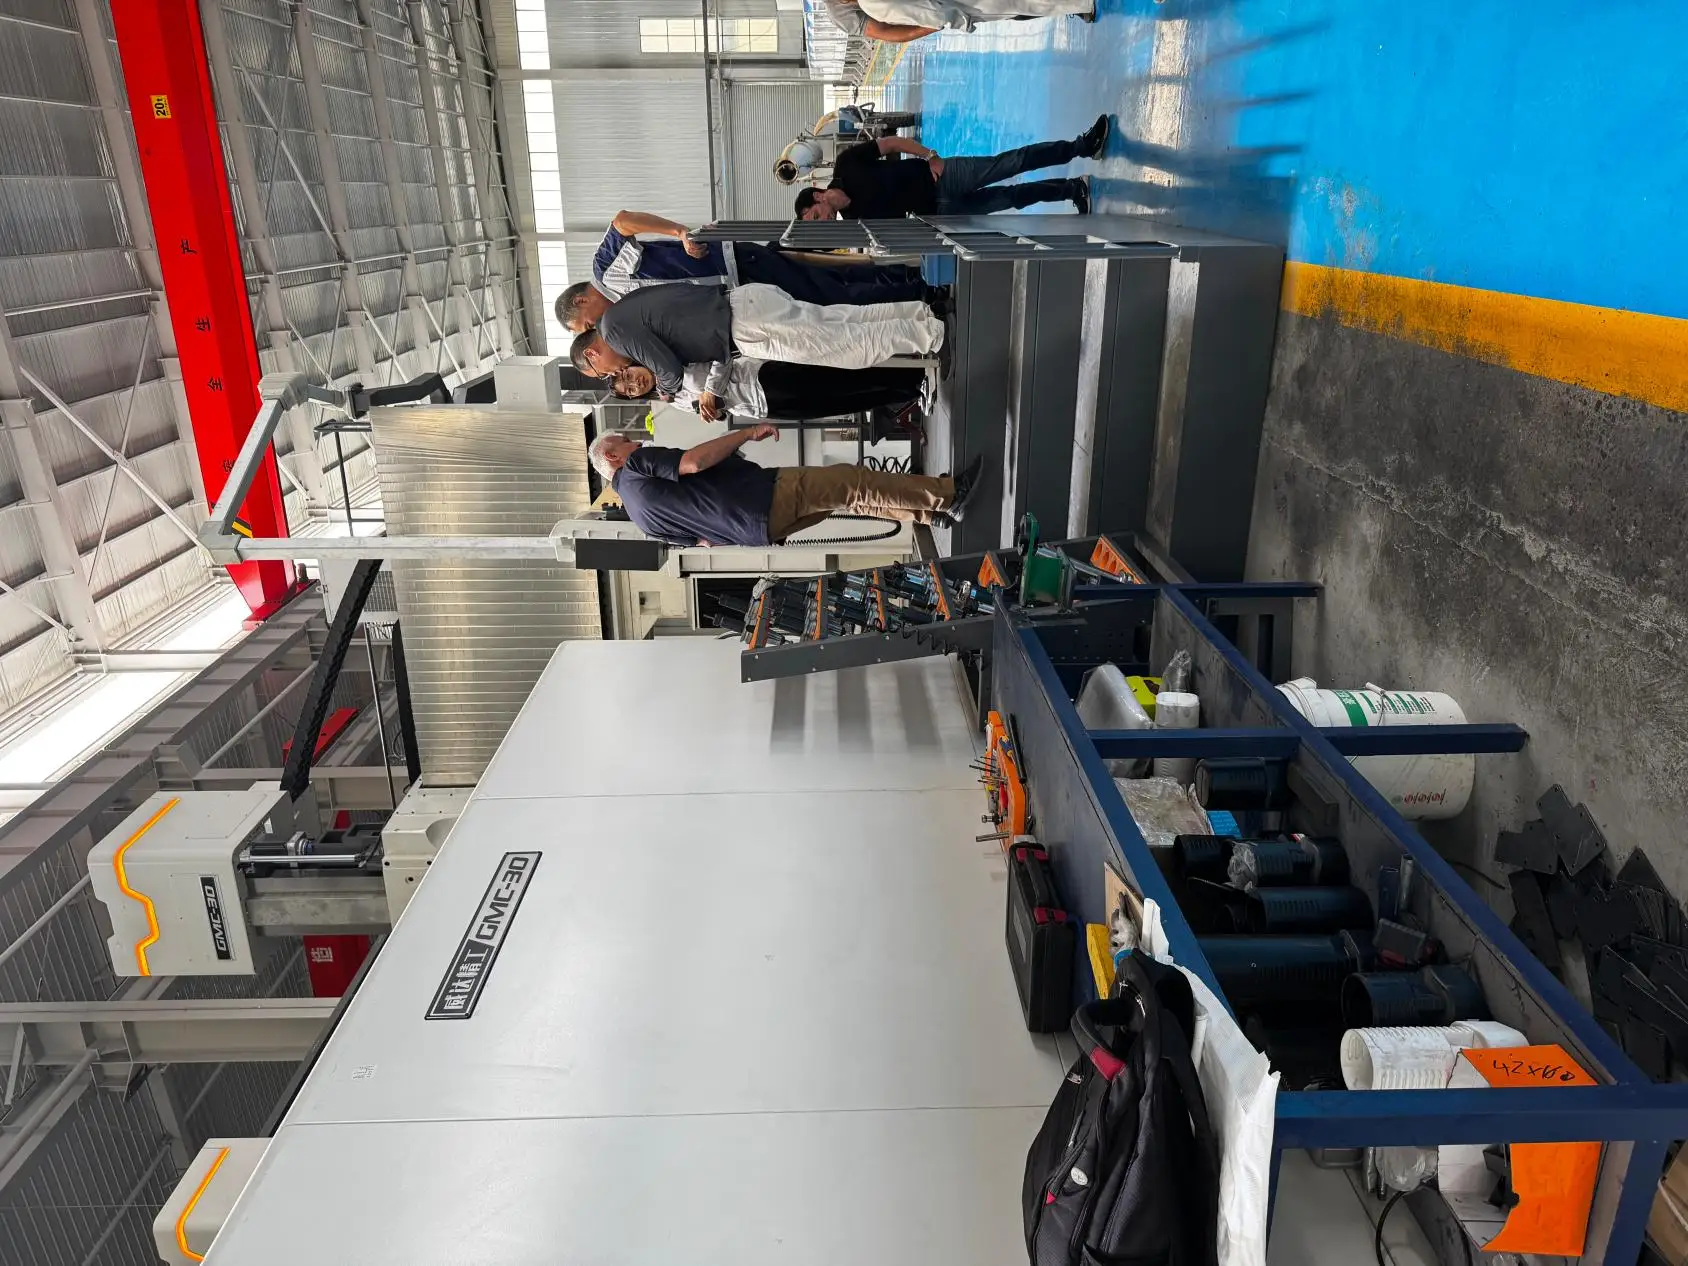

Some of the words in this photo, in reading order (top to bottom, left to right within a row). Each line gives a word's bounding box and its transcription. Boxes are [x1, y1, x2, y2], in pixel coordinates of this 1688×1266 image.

[204, 885, 227, 952] GMC-30
[443, 948, 490, 1010] 威达精工
[475, 857, 530, 940] GMC-30
